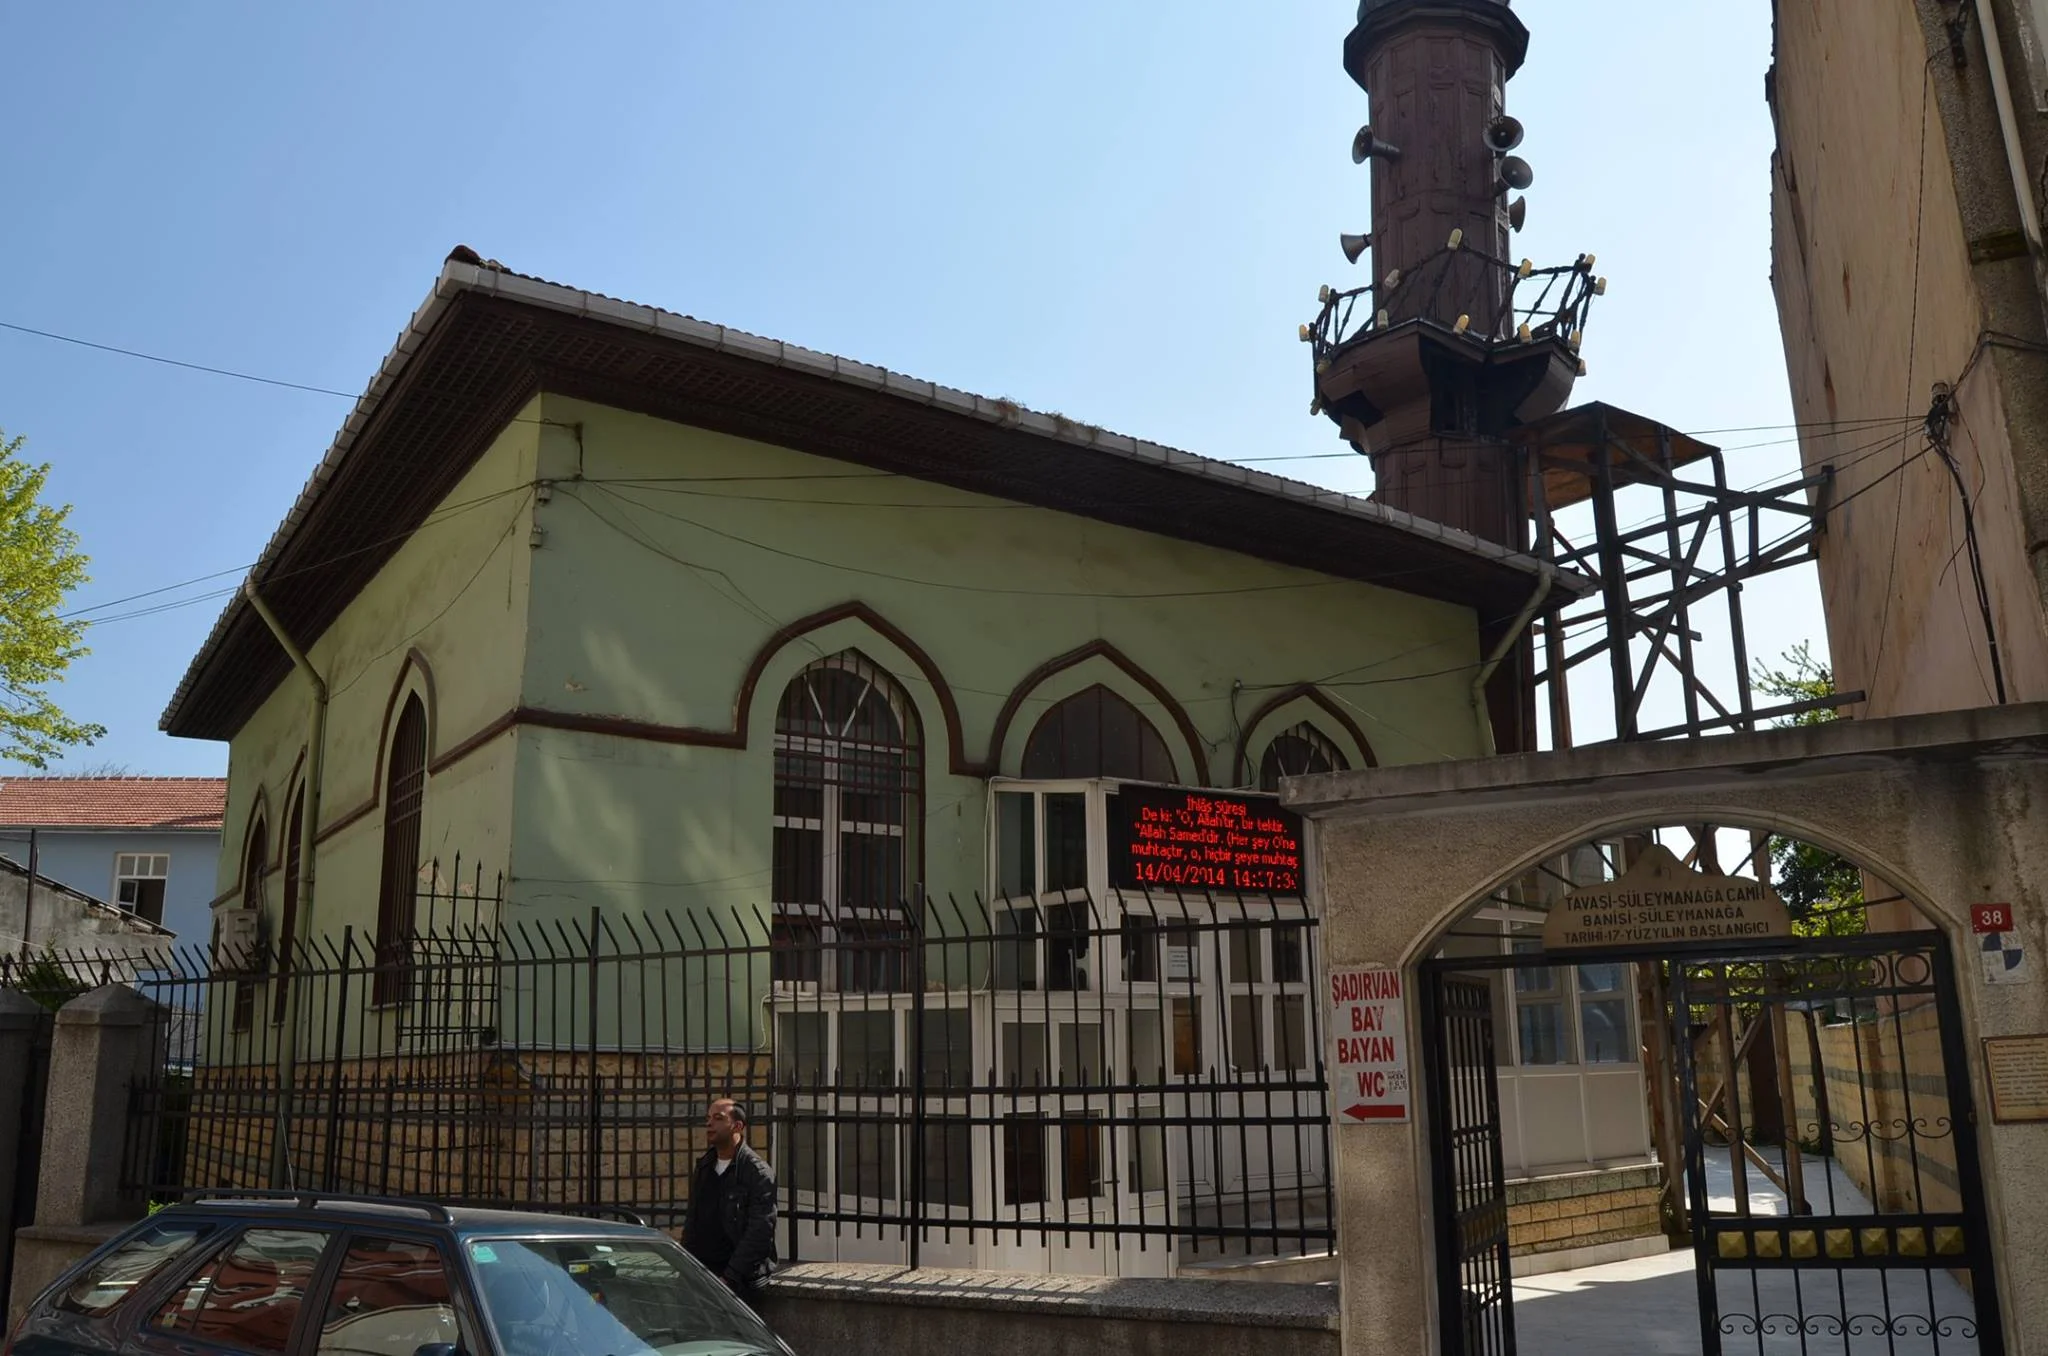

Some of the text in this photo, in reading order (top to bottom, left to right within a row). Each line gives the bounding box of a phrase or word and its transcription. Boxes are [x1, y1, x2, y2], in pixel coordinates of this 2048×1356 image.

[1142, 807, 1158, 821] De
[1242, 817, 1254, 830] bir
[1252, 837, 1268, 851] şey
[1234, 852, 1260, 866] şeye
[1981, 910, 2003, 926] 38
[1332, 971, 1400, 1009] ŞADIRVAN
[1351, 1005, 1385, 1032] BAY
[1337, 1036, 1395, 1064] BAYAN
[1357, 1071, 1385, 1098] WC
